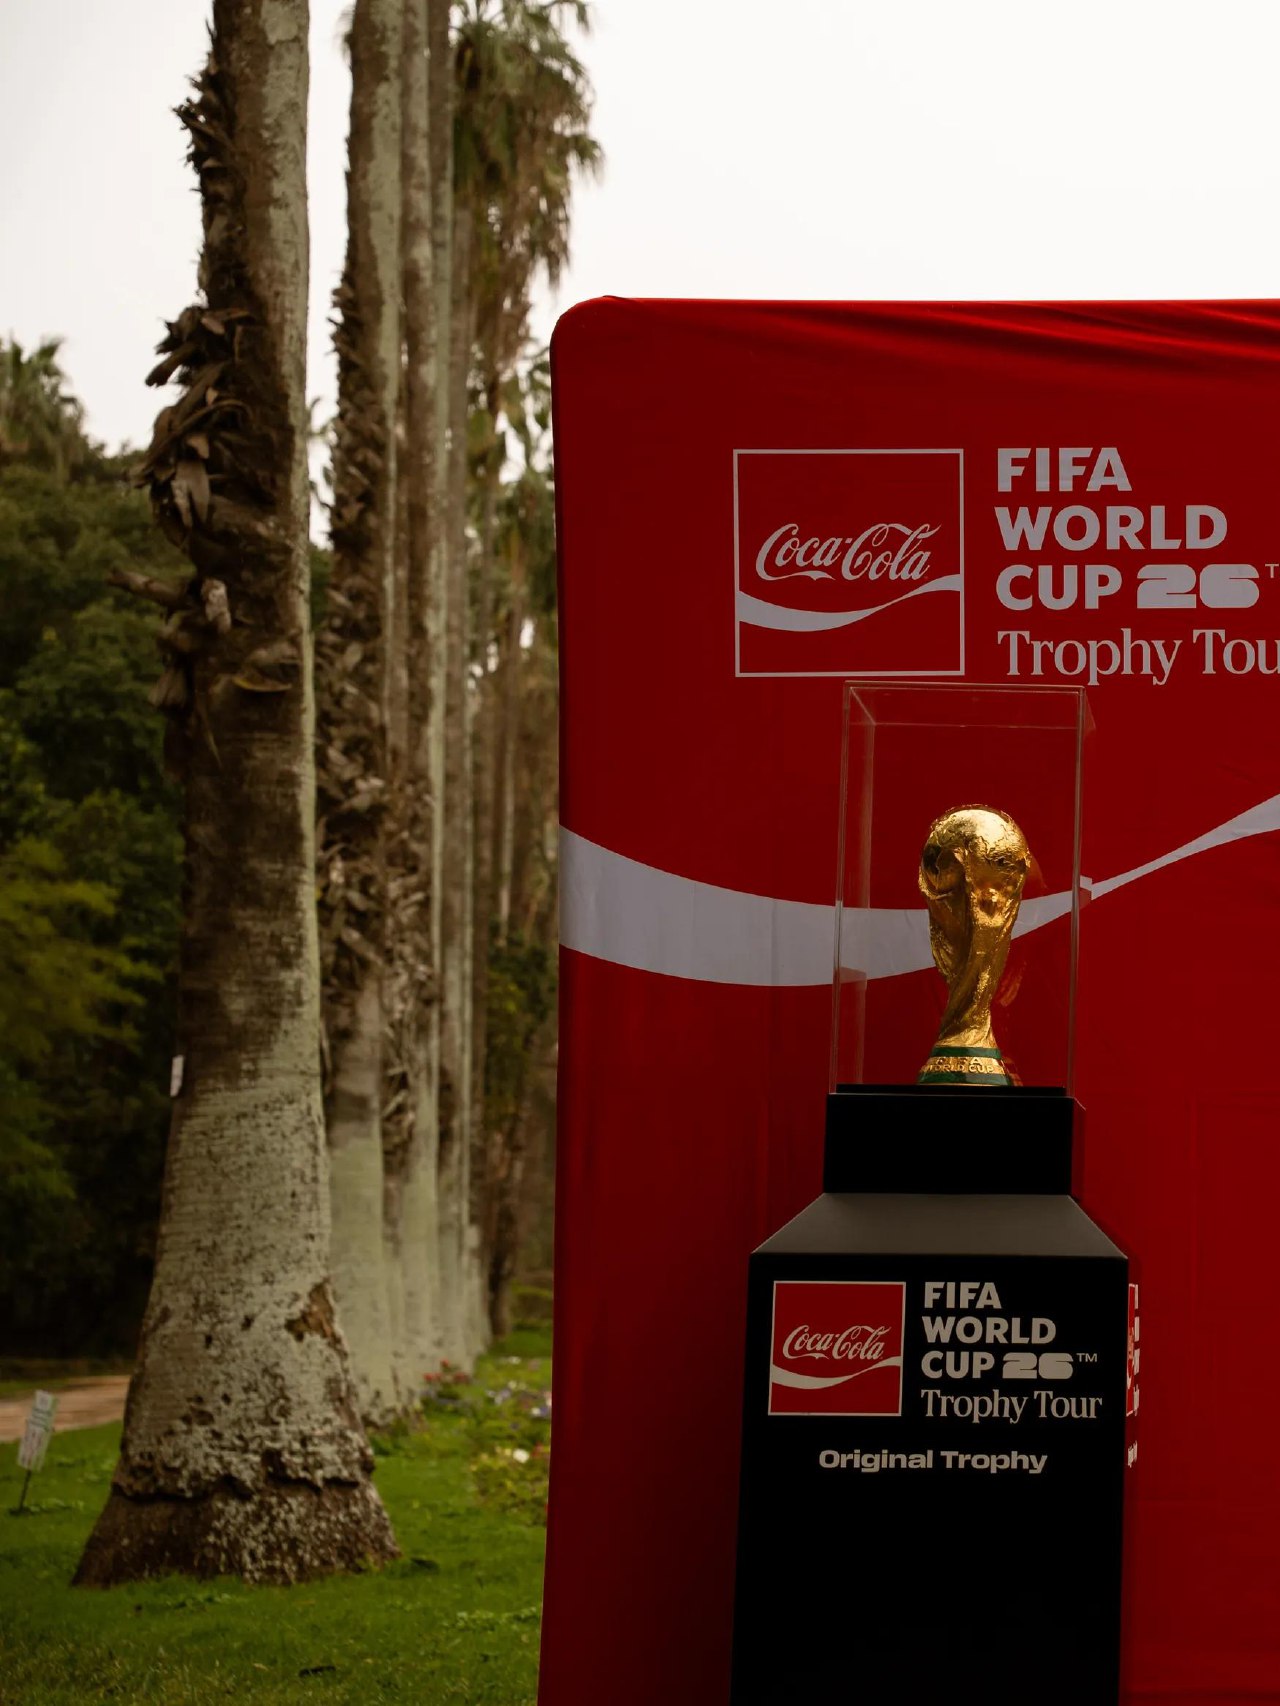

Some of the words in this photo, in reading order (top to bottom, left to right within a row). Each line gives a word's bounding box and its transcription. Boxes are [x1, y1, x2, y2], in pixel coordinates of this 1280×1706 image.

[997, 447, 1132, 492] FIFA
[994, 504, 1228, 551] WORLD
[755, 523, 942, 581] Coca-Cola
[996, 564, 1123, 611] CUP
[997, 628, 1183, 686] Trophy
[968, 1065, 994, 1073] CUP
[924, 1281, 1002, 1309] FIFA
[782, 1324, 892, 1360] Coca-Cola
[921, 1316, 1057, 1344] WORLD
[921, 1351, 995, 1379] CUP
[920, 1389, 1028, 1424] Trophy
[1034, 1390, 1103, 1419] Tour
[819, 1449, 933, 1474] Original
[940, 1450, 1048, 1475] Trophy
